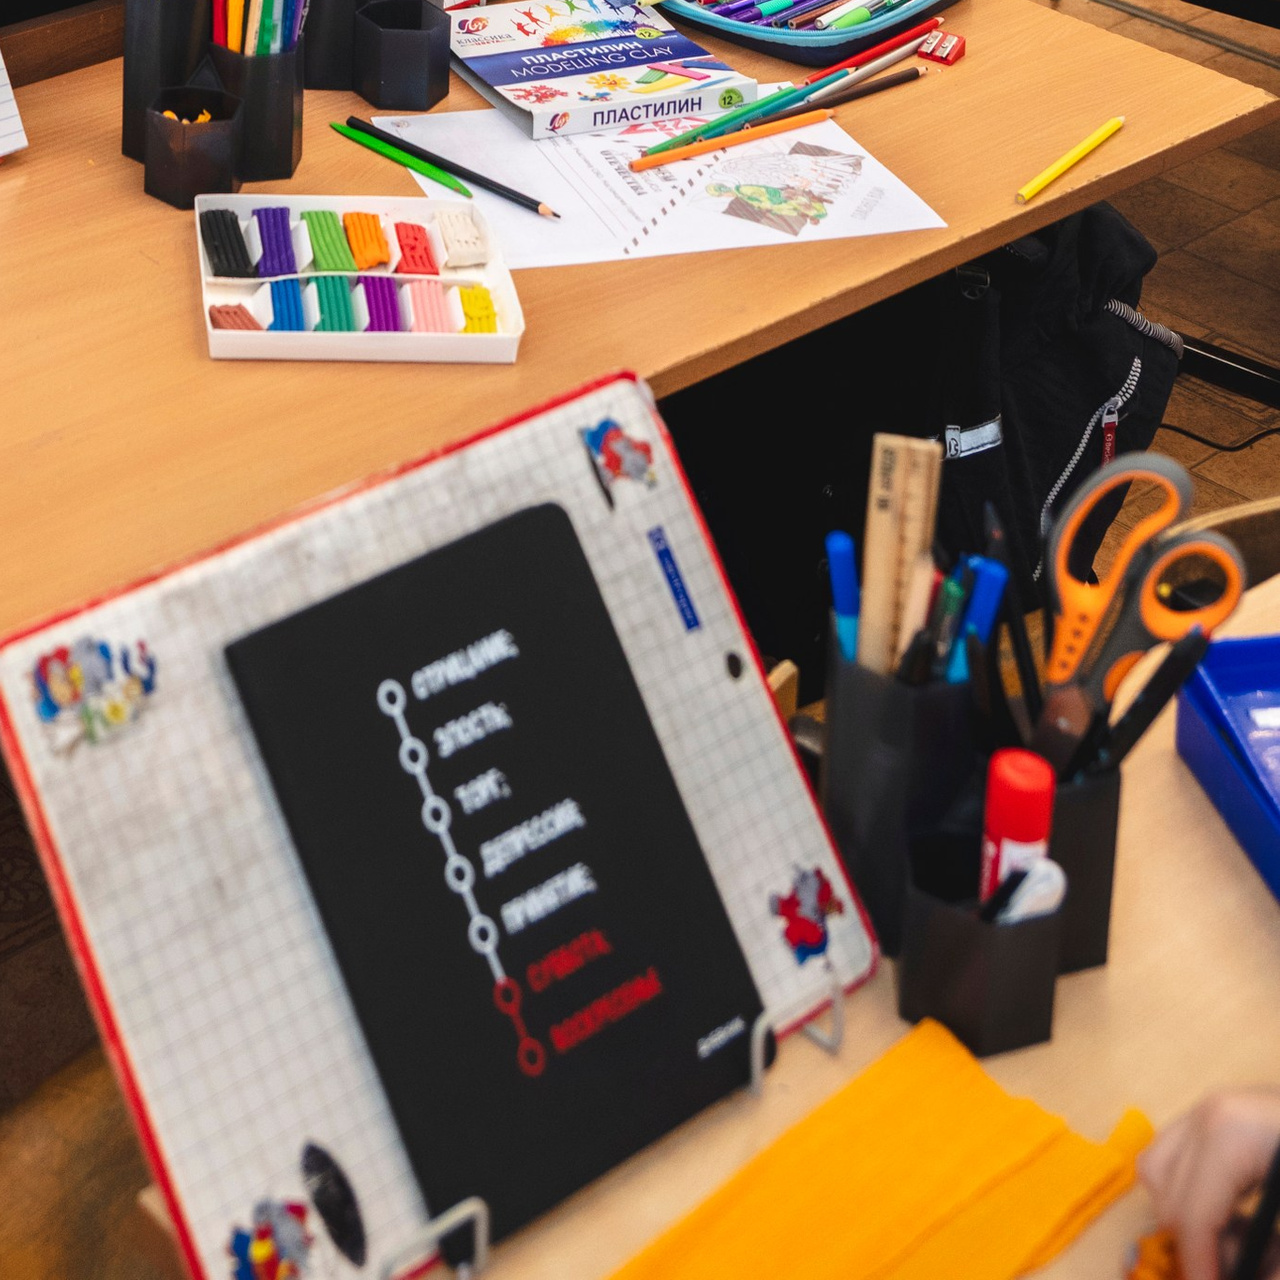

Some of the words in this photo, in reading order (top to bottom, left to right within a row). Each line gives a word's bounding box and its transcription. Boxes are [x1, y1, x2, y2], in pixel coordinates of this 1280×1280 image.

[456, 33, 512, 46] классика
[511, 52, 627, 78] MODELLING
[629, 45, 675, 64] CLAY
[522, 41, 643, 66] ПЛАСТИЛИН
[593, 96, 702, 127] ПЛАСТИЛИН
[722, 94, 732, 106] 12
